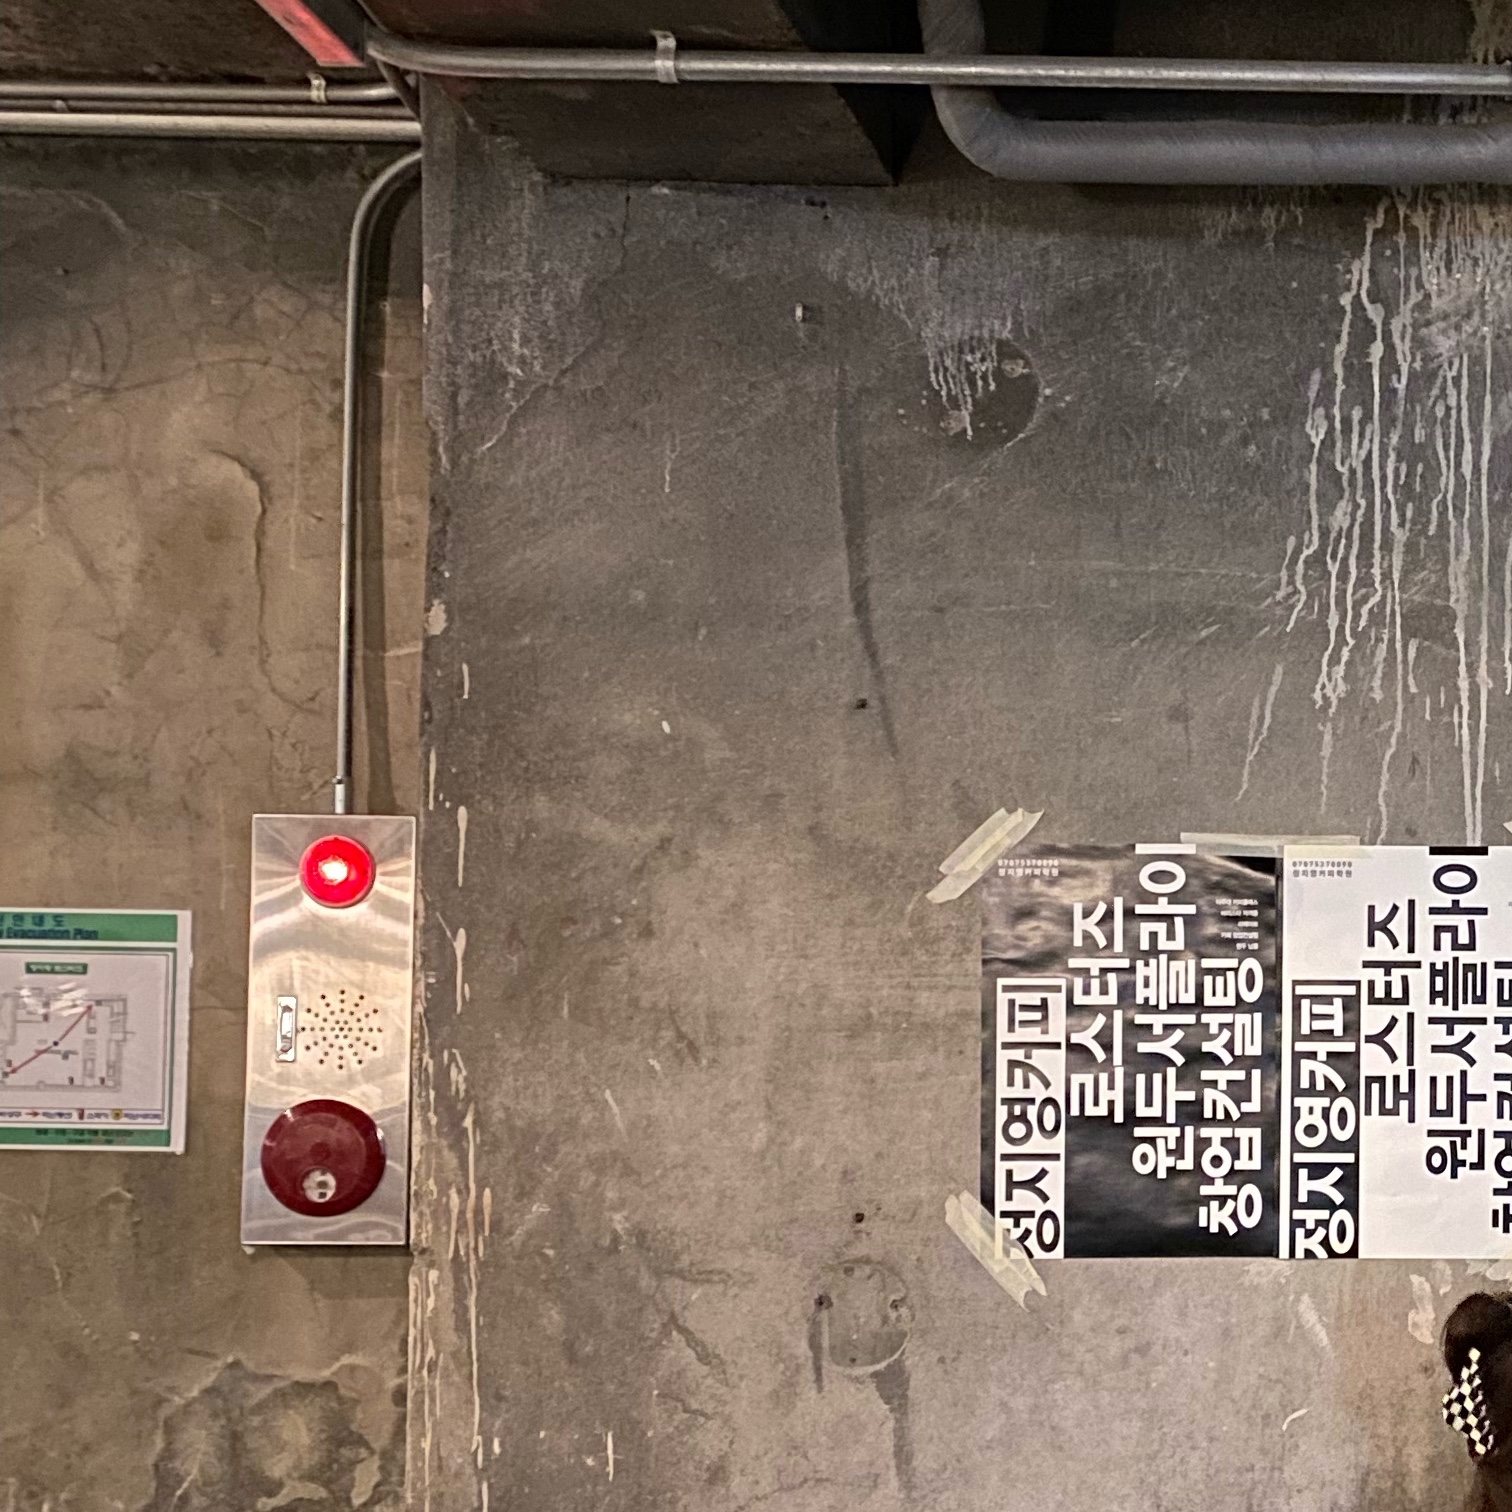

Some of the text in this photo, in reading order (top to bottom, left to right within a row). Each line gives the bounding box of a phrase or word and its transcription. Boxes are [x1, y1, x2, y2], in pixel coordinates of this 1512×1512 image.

[999, 984, 1061, 1259] 정지영커피
[1068, 897, 1130, 1123] 로스터즈
[1132, 843, 1197, 1179] 원두서플라이
[1199, 957, 1264, 1237] 창업컨설팅
[1292, 984, 1357, 1259] 정지영커피
[1362, 898, 1422, 1124] 로스터즈
[1425, 845, 1489, 1179] 원두서플라이
